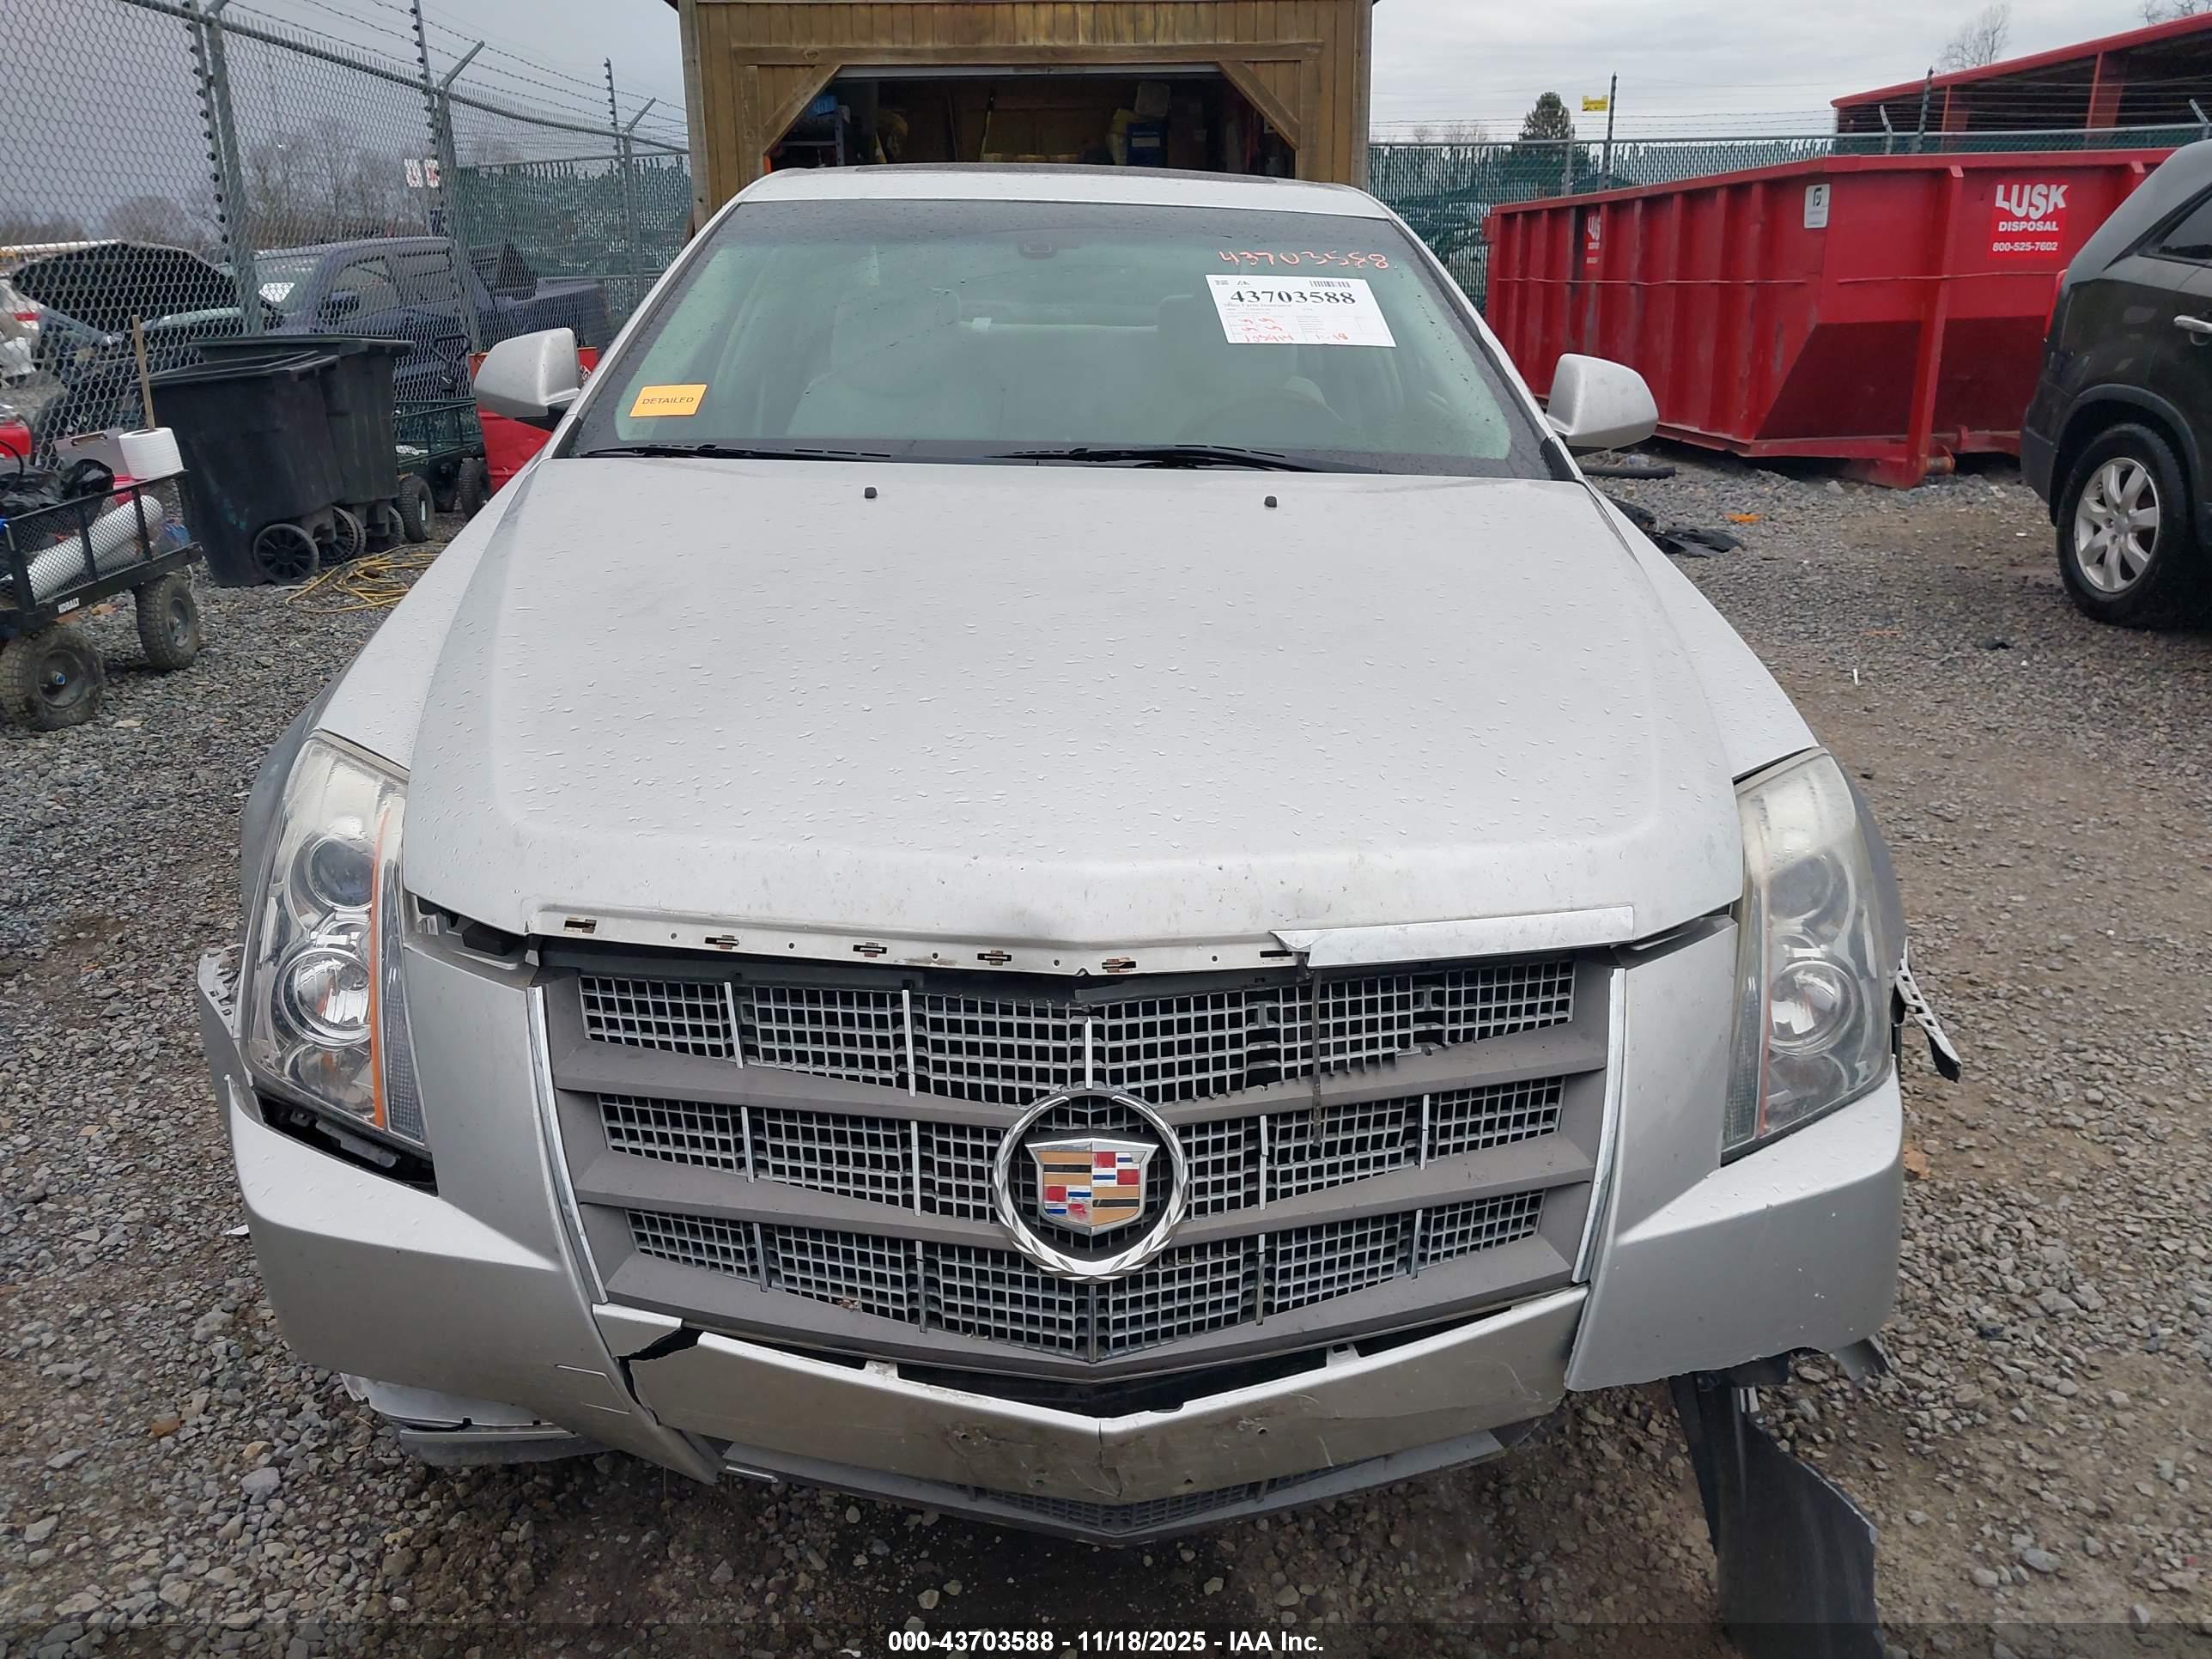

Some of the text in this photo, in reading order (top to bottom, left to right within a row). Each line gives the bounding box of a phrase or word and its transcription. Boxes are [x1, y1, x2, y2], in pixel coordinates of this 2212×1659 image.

[1995, 183, 2069, 220] LUSK
[1998, 221, 2059, 232] DISPOSAL
[1991, 241, 2059, 252] 800-525-7602
[1218, 250, 1389, 269] 43703588
[1231, 290, 1356, 305] 43703588
